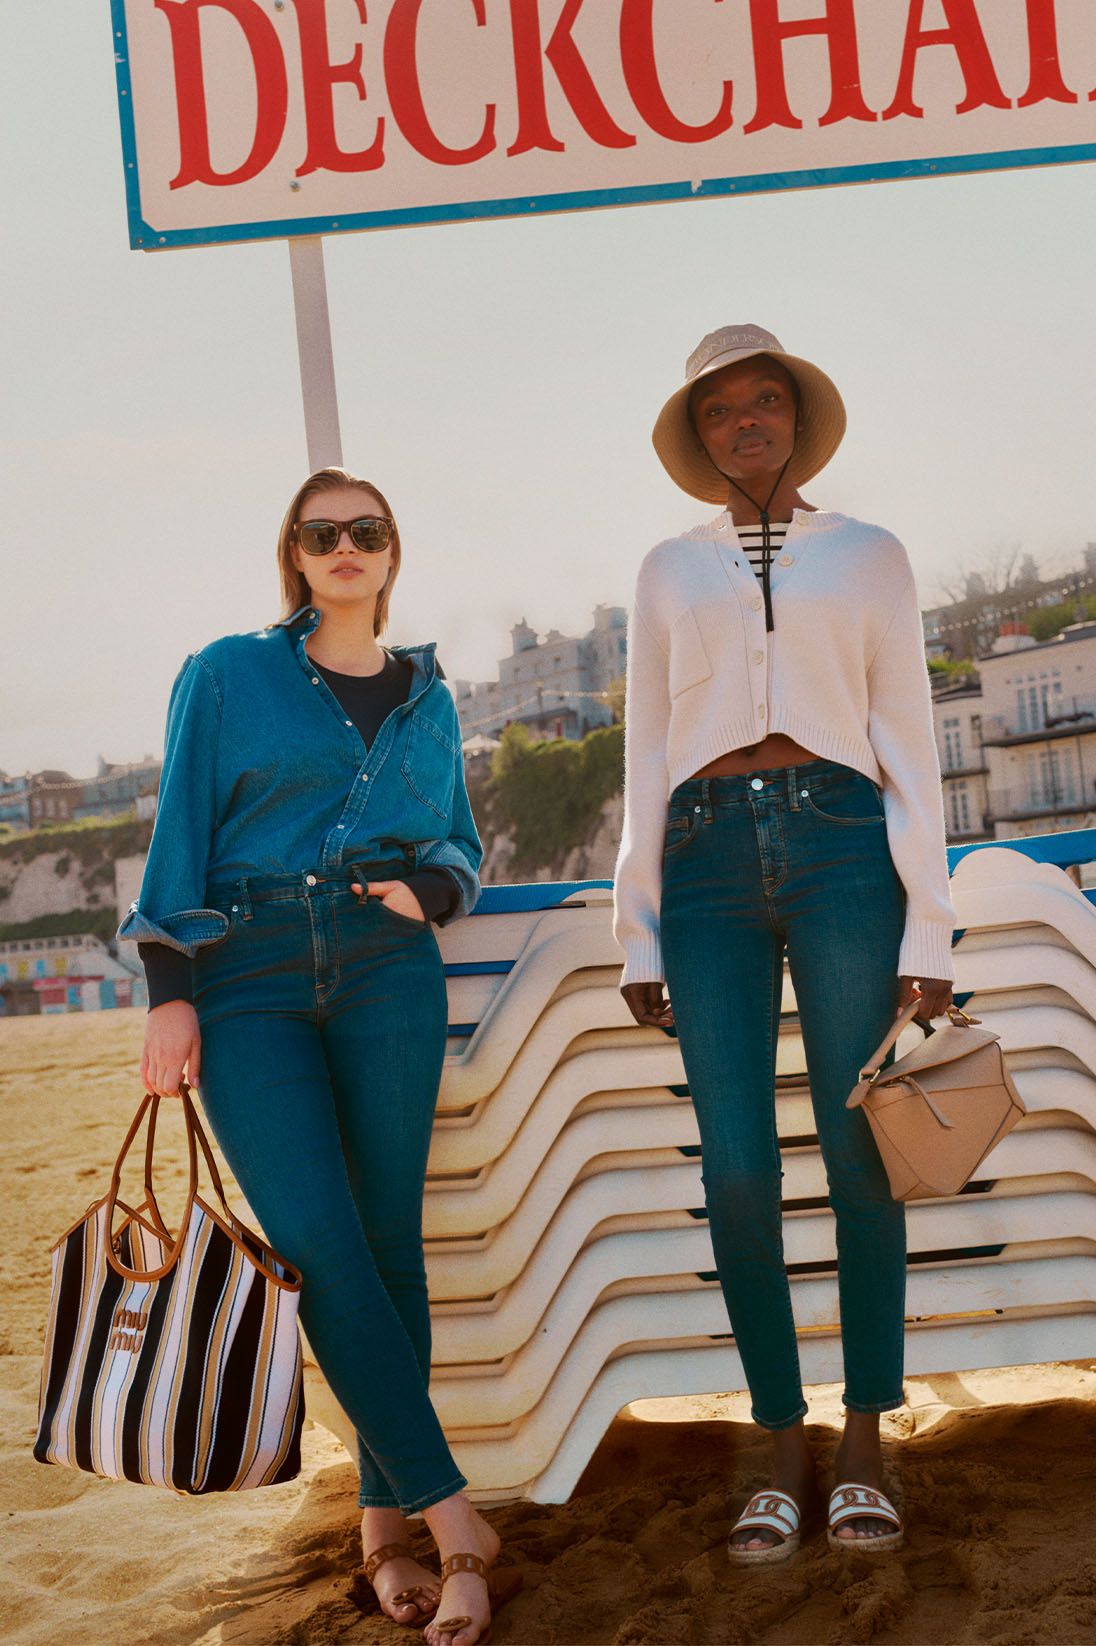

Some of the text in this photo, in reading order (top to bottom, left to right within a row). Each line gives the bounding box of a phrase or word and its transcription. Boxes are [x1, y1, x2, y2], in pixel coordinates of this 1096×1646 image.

[154, 0, 1096, 190] DECKCHAI
[113, 1310, 148, 1331] miu
[109, 1333, 143, 1354] miu
